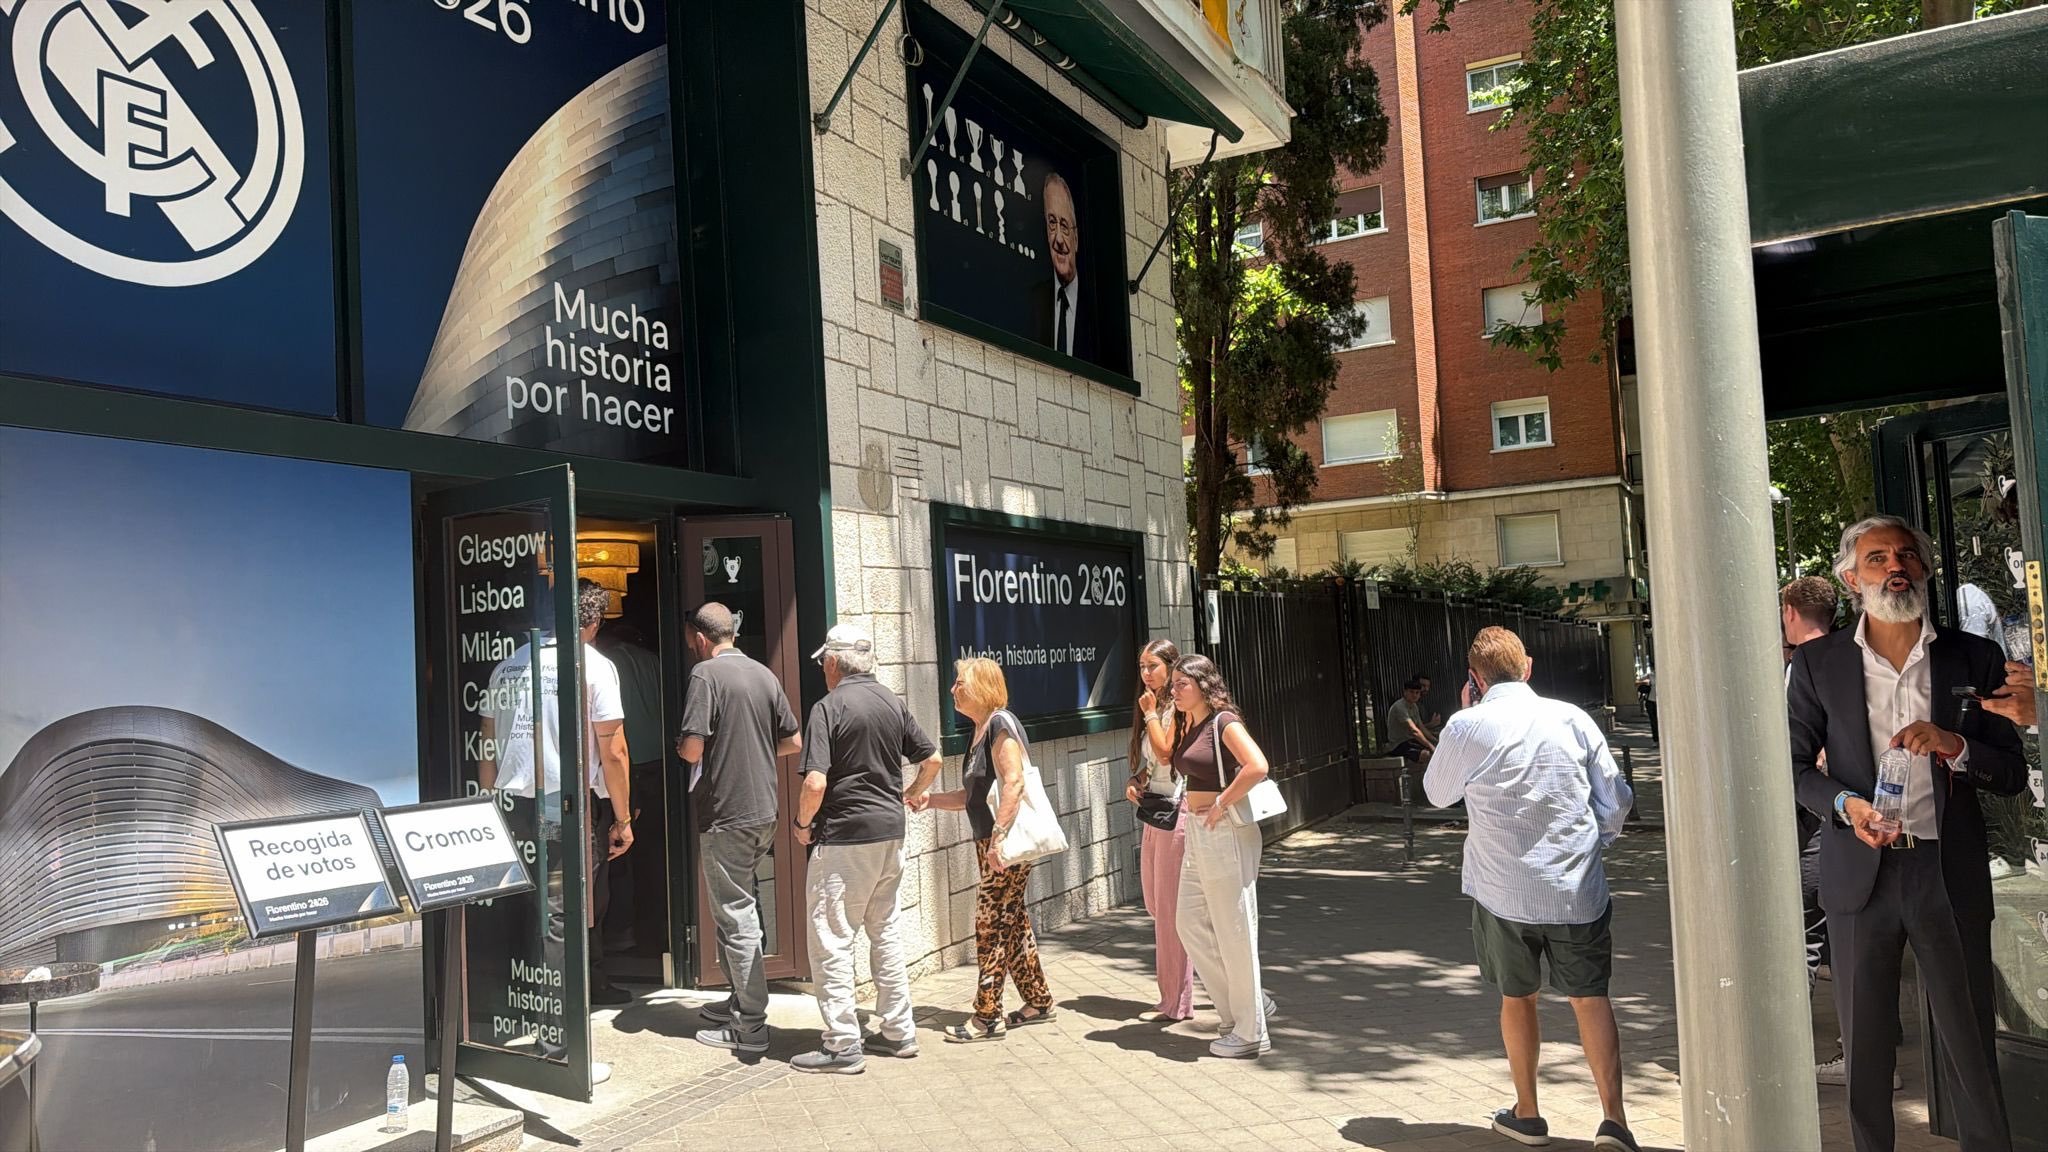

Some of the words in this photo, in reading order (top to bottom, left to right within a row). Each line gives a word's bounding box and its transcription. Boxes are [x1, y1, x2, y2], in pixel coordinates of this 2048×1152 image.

[554, 281, 669, 350] Mucha
[546, 325, 671, 392] historia
[506, 376, 568, 420] por
[581, 379, 674, 434] hacer
[459, 531, 546, 568] Glasgow
[954, 553, 1073, 605] Florentino
[460, 581, 524, 614] Lisboa
[461, 631, 515, 663] Milán
[1006, 644, 1047, 666] historia
[1050, 648, 1067, 669] por
[1070, 643, 1096, 663] hacer
[465, 731, 506, 761] Kiev
[248, 830, 353, 858] Recogida
[405, 825, 496, 852] Cromos
[266, 862, 296, 881] de
[298, 856, 356, 876] votos
[423, 879, 458, 892] Florentino
[265, 901, 308, 915] Florentino
[511, 958, 562, 987] Mucha
[508, 985, 563, 1016] historia
[493, 1015, 517, 1038] por
[521, 1014, 564, 1044] hacer
